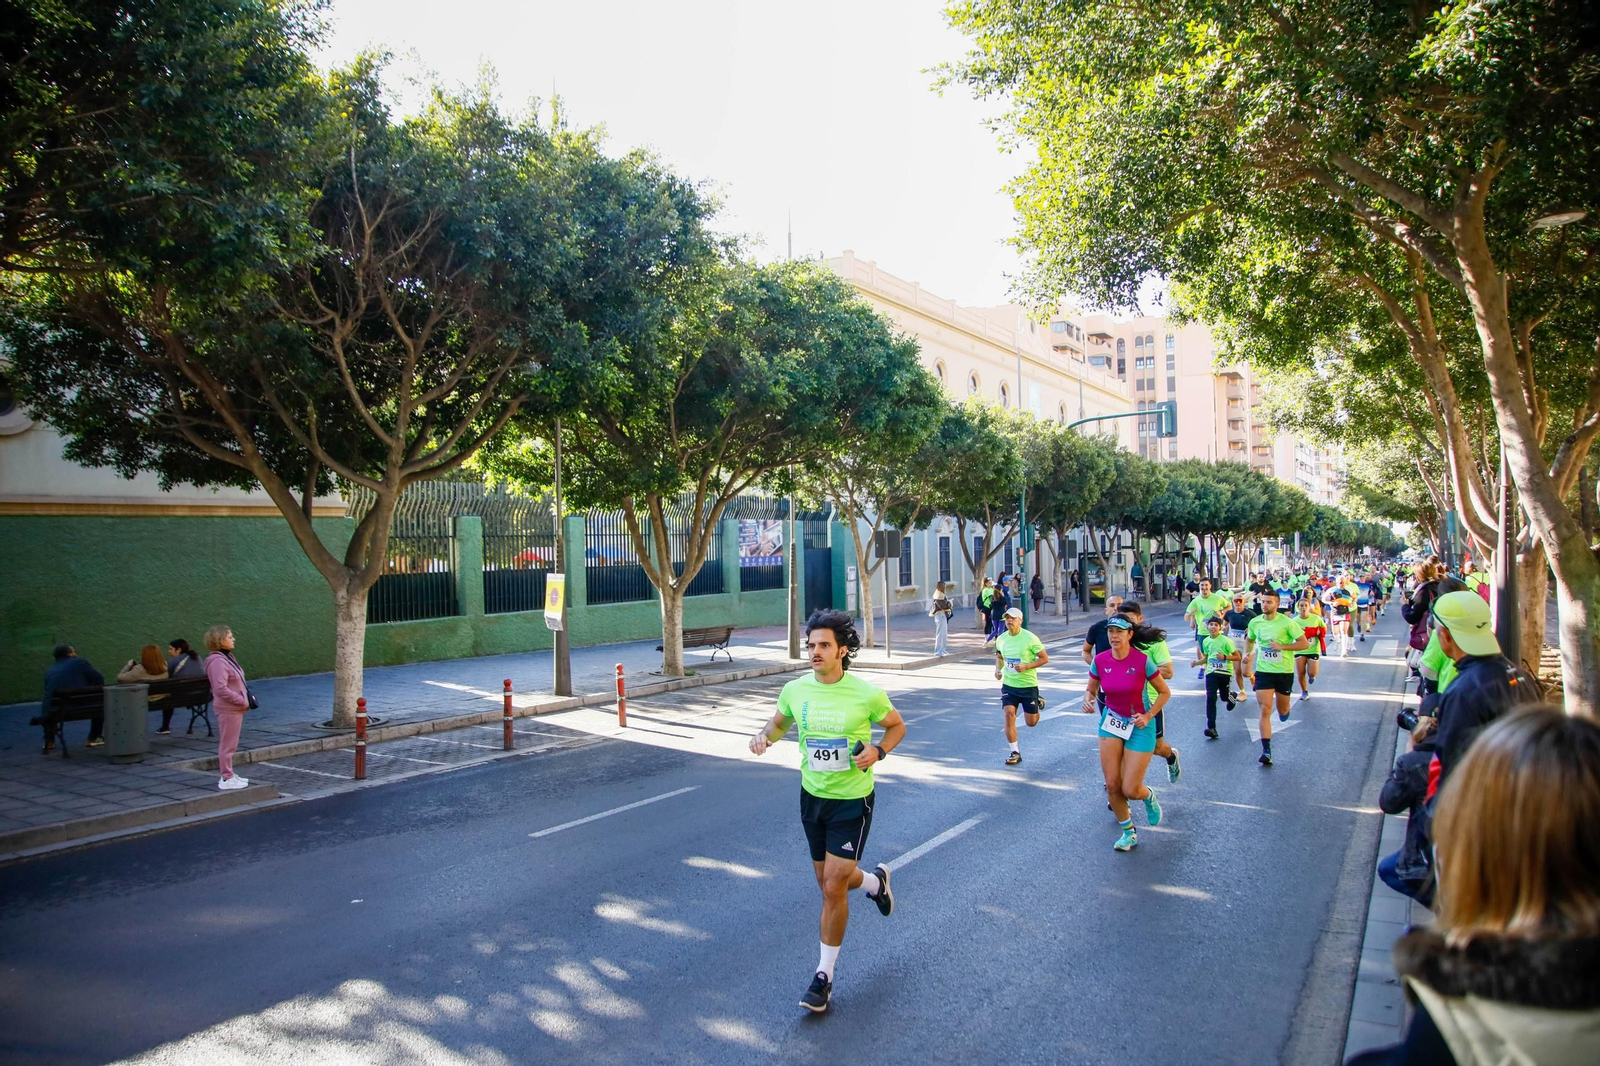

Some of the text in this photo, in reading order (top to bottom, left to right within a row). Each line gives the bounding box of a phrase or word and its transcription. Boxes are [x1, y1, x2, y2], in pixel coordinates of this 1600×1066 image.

[809, 723, 846, 732] cáncer
[1110, 718, 1127, 731] 636
[814, 749, 839, 761] 491
